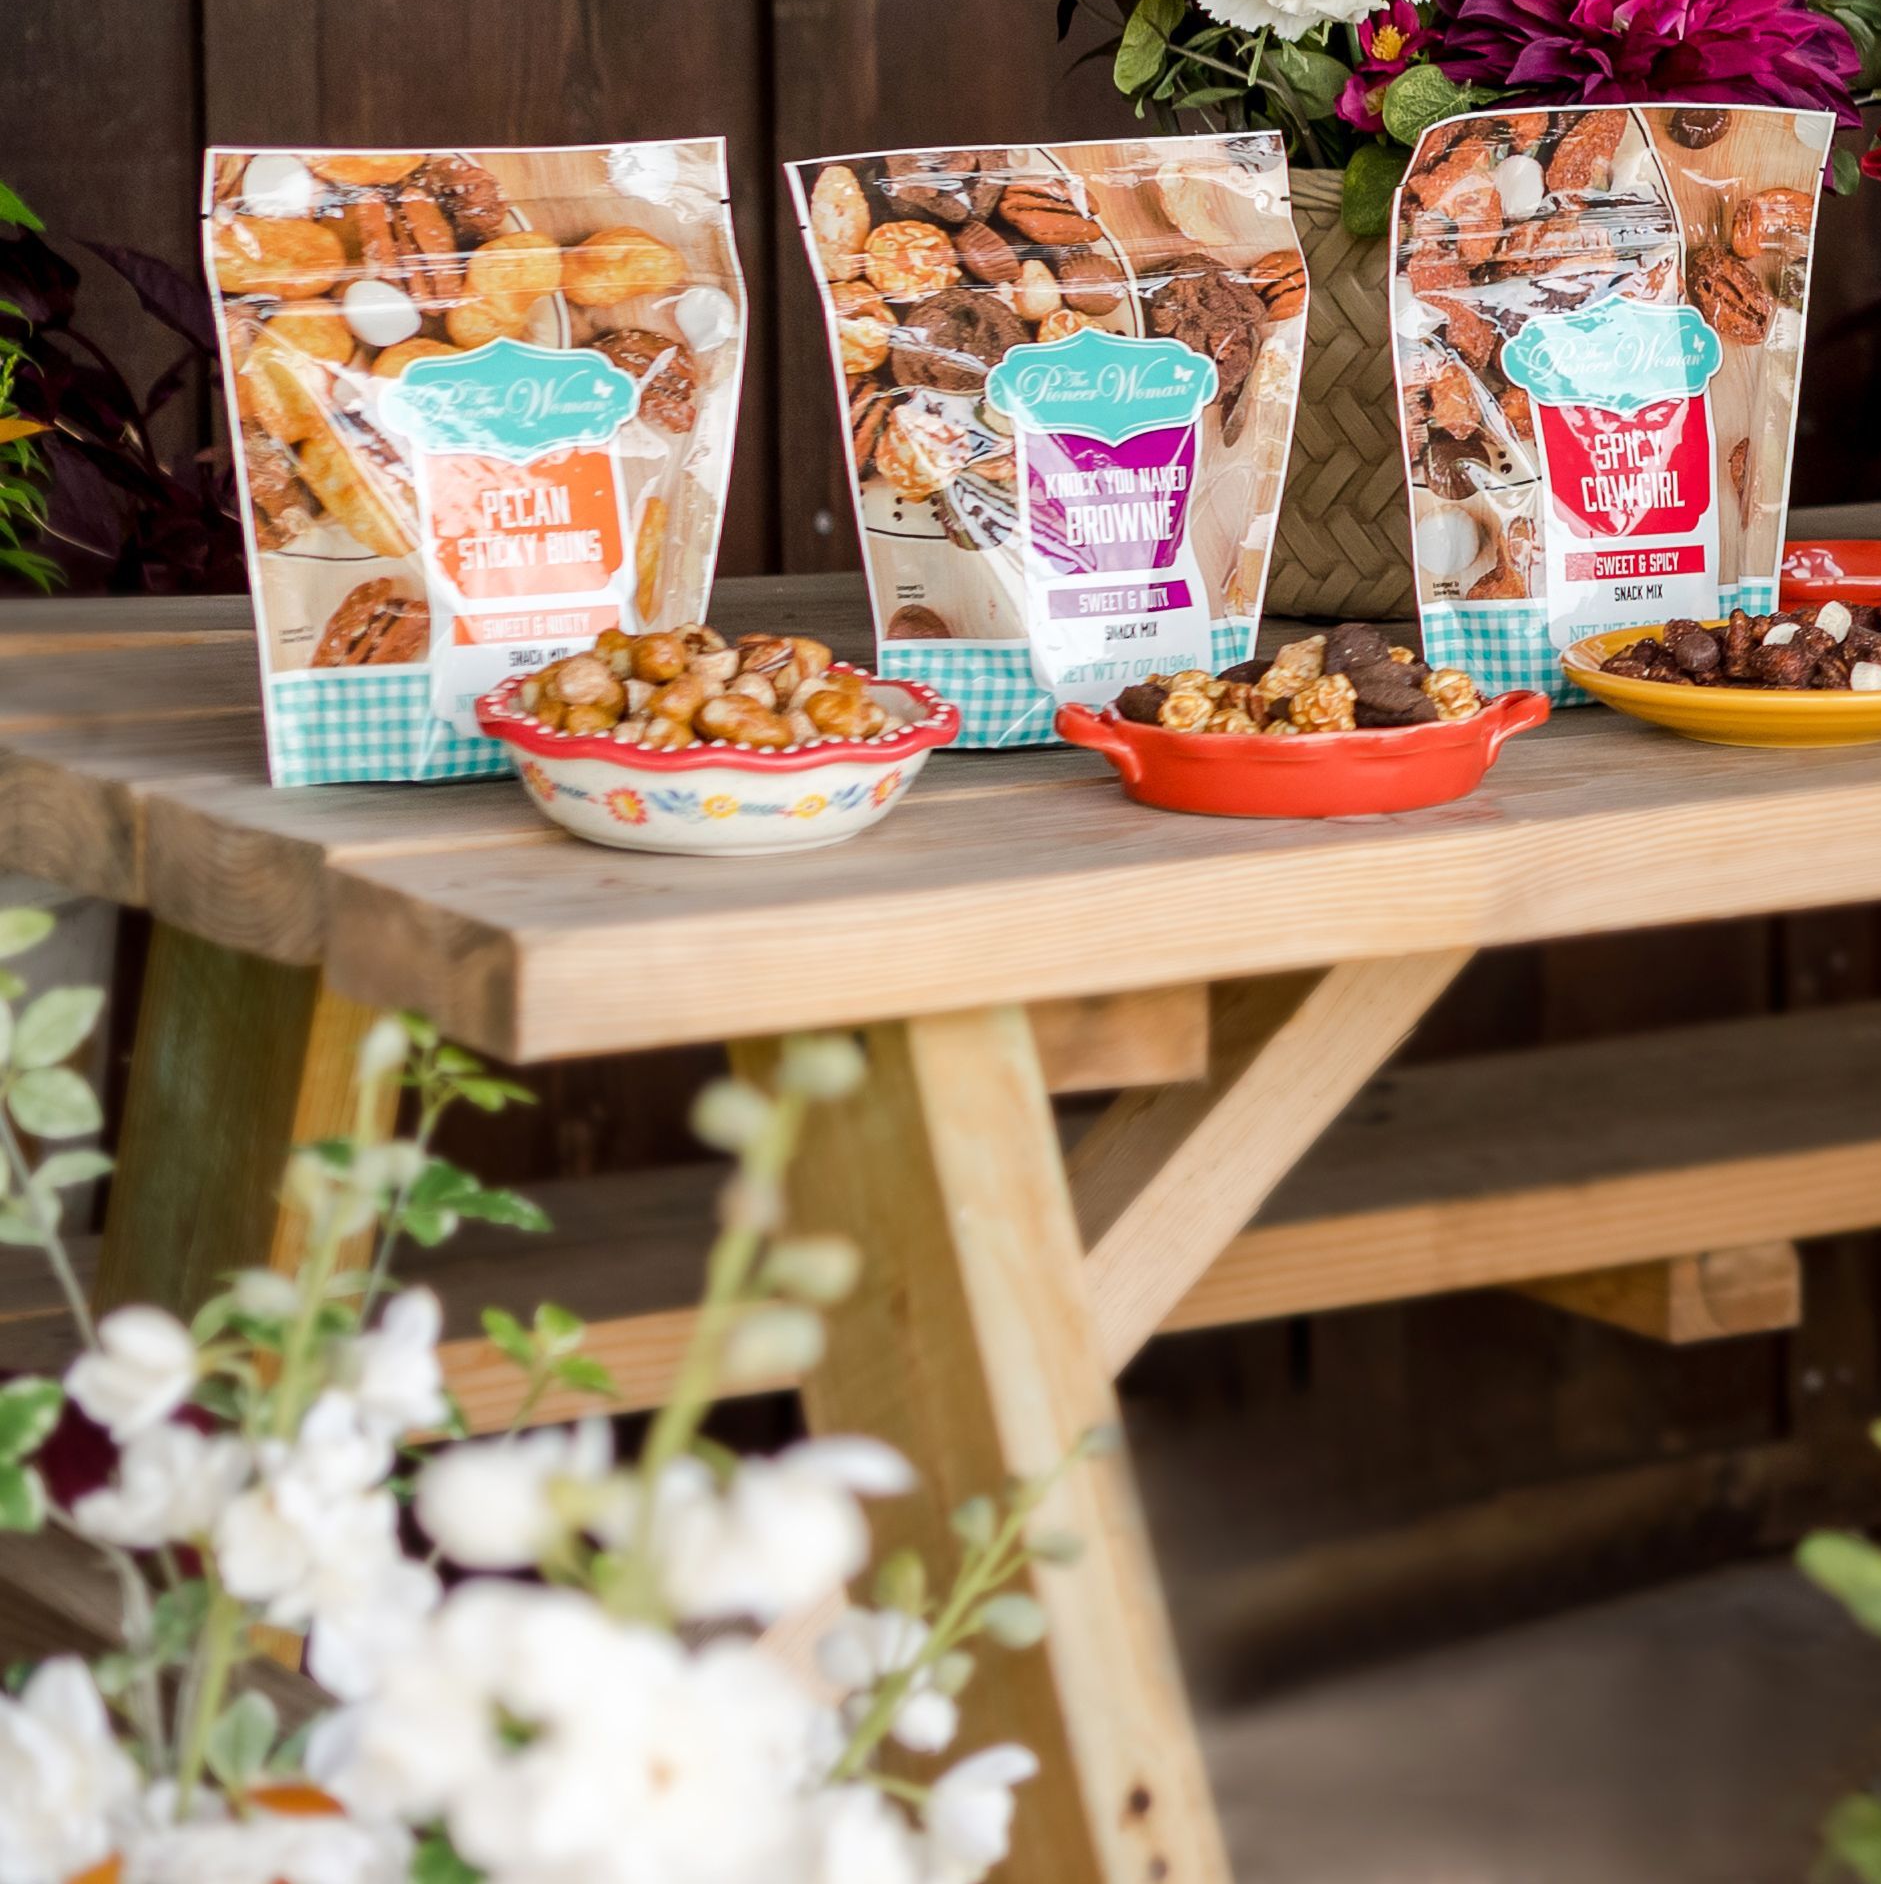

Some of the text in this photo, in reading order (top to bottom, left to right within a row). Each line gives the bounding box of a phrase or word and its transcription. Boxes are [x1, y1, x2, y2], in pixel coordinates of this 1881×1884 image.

[1528, 325, 1701, 381] Pioneer Woman
[1016, 357, 1190, 407] Pioneer Woman
[1063, 370, 1090, 388] The
[1594, 429, 1663, 470] SPICY
[1045, 466, 1187, 499] KNOCK YOU NAKED
[1581, 470, 1686, 513] COWGIRL
[482, 485, 572, 529] PECAN
[1066, 500, 1177, 547] BROWNIE
[457, 529, 604, 571] STICKY BUNS
[1596, 552, 1680, 576] SWEET & SPICY
[1079, 587, 1170, 613] SWEET & NUTTY
[1614, 584, 1663, 602] SNACK MIX
[1104, 621, 1159, 641] SNACK MIX
[1092, 662, 1118, 682] WT
[1121, 660, 1131, 680] 7
